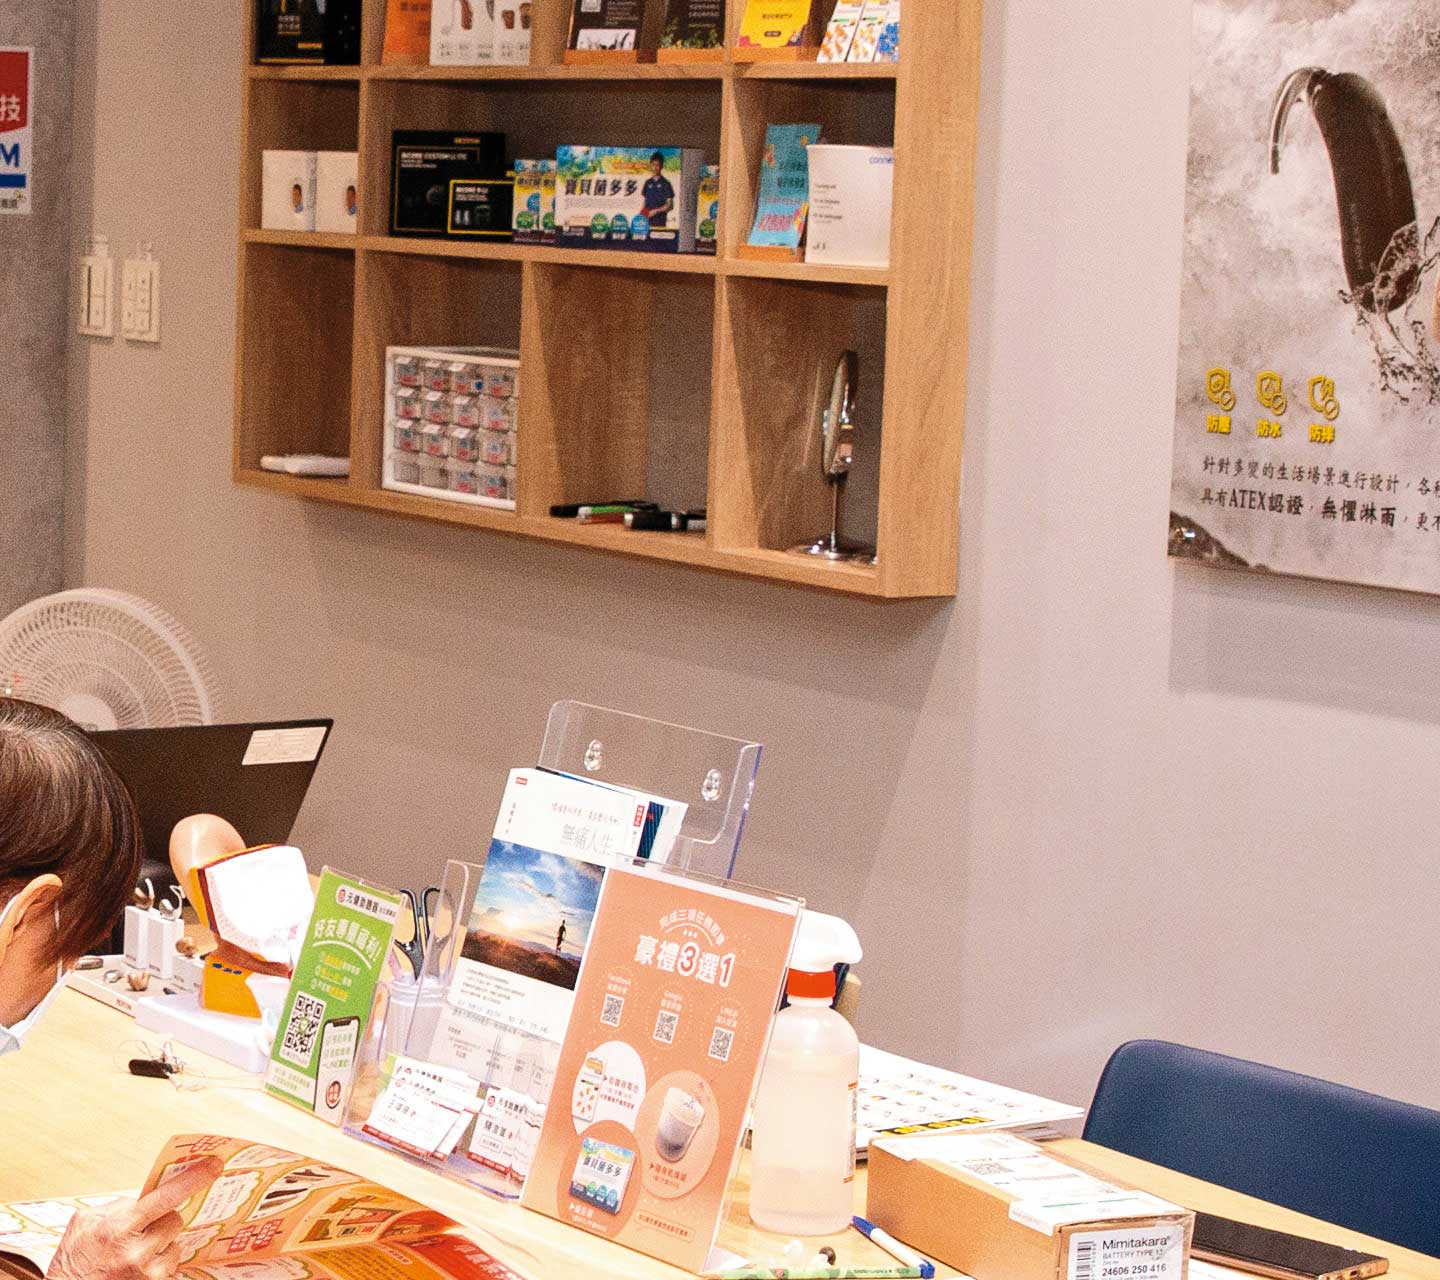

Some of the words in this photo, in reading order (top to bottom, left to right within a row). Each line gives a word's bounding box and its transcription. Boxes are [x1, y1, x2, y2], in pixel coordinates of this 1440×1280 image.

[633, 933, 737, 989] 豪禮3選1
[1102, 1250, 1135, 1260] BATTERY
[1136, 1249, 1154, 1258] TYPE
